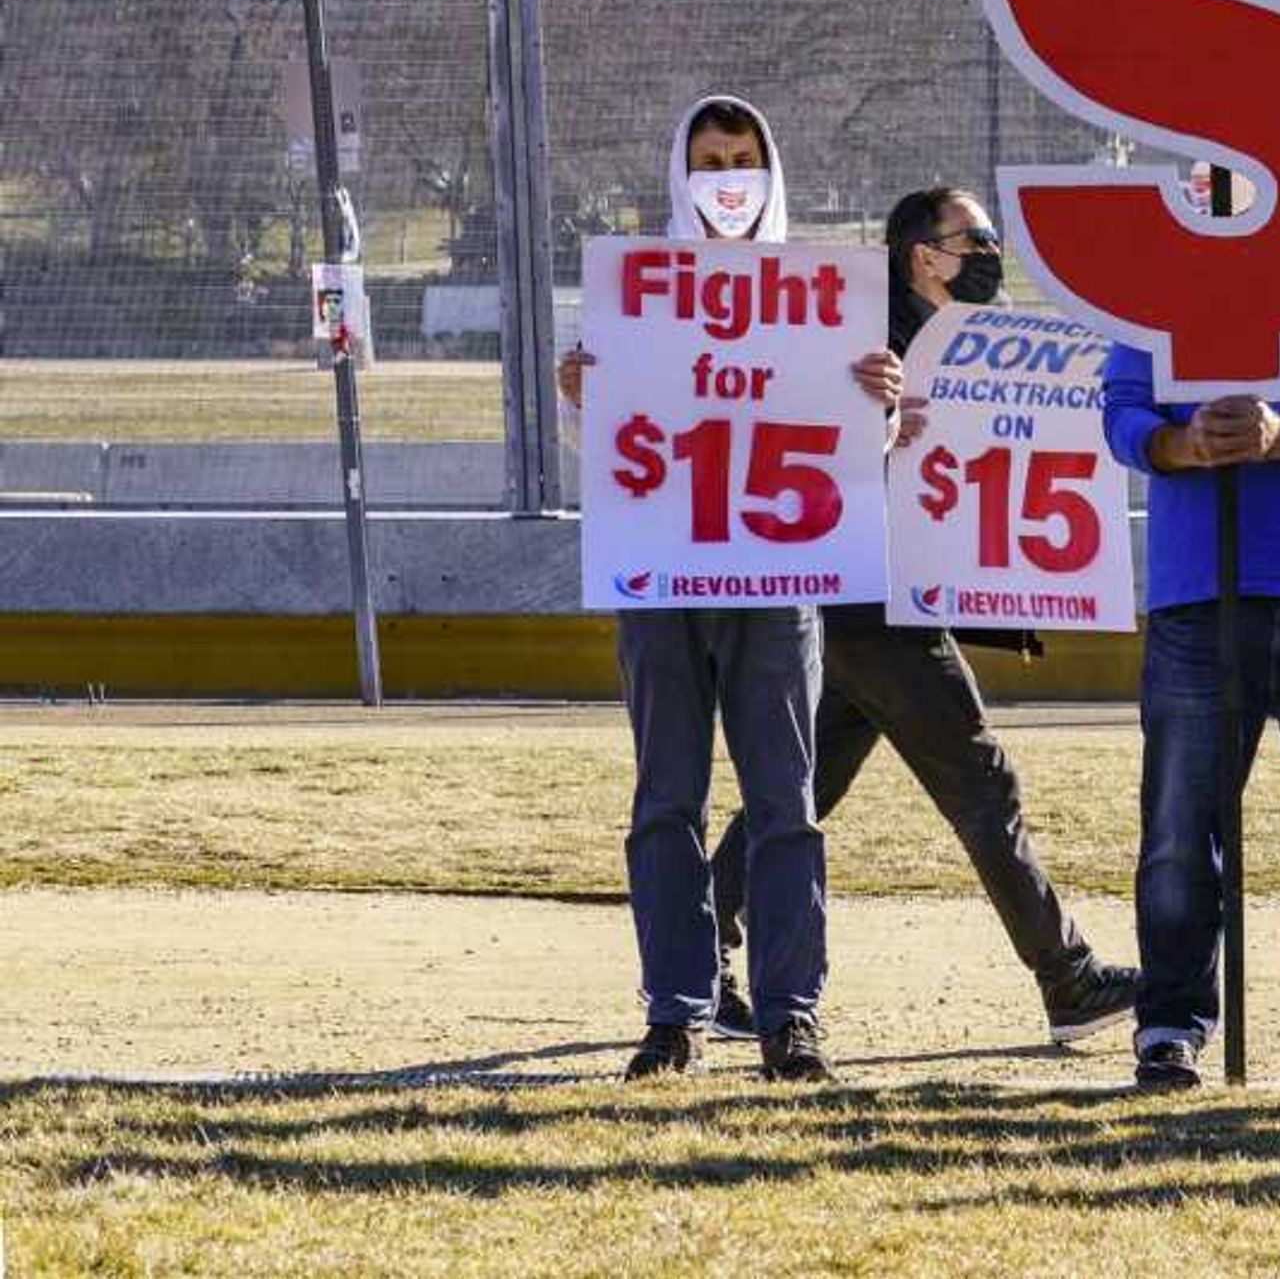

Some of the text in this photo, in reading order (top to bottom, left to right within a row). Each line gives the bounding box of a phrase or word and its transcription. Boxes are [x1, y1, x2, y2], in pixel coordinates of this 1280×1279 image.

[619, 247, 847, 342] Fight
[692, 353, 775, 402] for
[930, 377, 1107, 410] BACKTRACK
[992, 413, 1034, 440] ON
[612, 412, 844, 543] $15
[919, 446, 1104, 576] $15
[671, 573, 842, 597] REVOLUTION
[958, 590, 1097, 620] REVOLUTION
